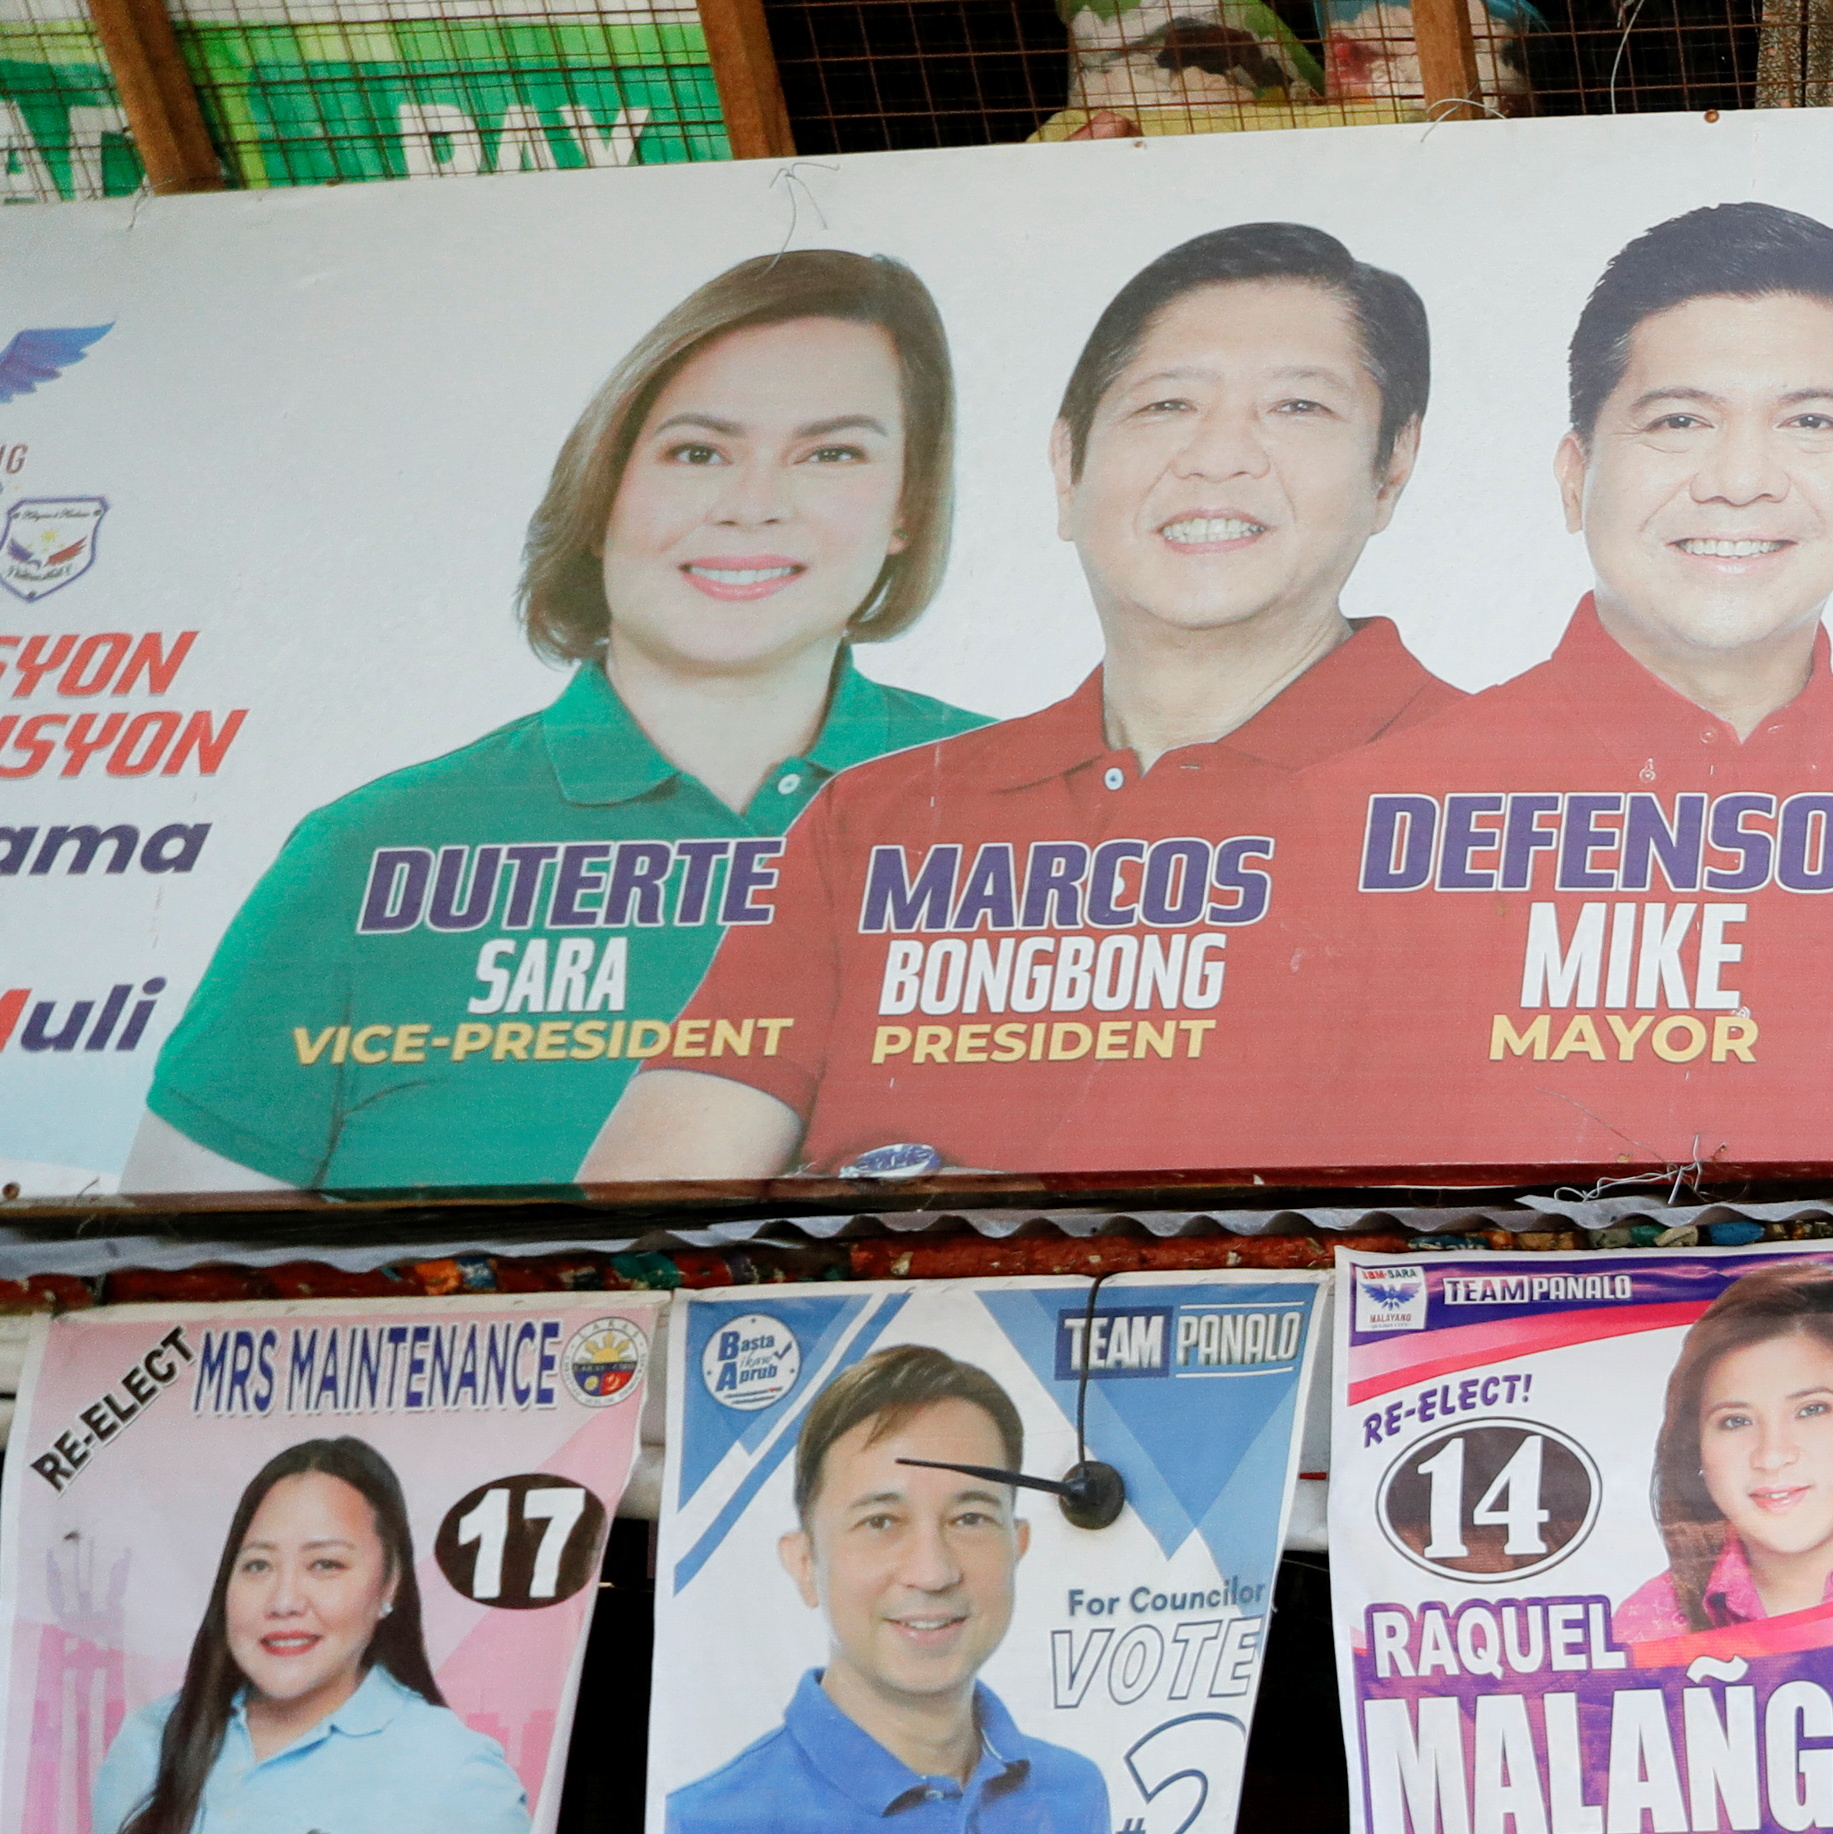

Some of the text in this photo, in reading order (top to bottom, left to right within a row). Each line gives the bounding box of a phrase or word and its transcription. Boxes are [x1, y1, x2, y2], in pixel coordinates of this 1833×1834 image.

[357, 838, 785, 933] DUTERTE
[858, 836, 1275, 933] MARCOS
[467, 938, 628, 1016] SARA
[877, 933, 1227, 1015] BONGBONG
[1520, 902, 1749, 1010] MIKE
[292, 1018, 793, 1065] VICE-PRESIDENT
[872, 1018, 1216, 1064] PRESIDENT
[1489, 1014, 1759, 1063] MAYOR
[1448, 1275, 1631, 1303] TEAM PANALO
[193, 1320, 561, 1414] MRS MAINTENANCE
[1177, 1306, 1302, 1367] PANALO
[31, 1326, 197, 1492] RE-ELECT
[1363, 1375, 1533, 1447] RE-ELECT!
[1417, 1435, 1549, 1557] 14
[458, 1488, 587, 1600] 17
[1069, 1576, 1265, 1618] For Councilor
[1050, 1615, 1262, 1711] VOTE
[1366, 1598, 1626, 1681] RAQUEL
